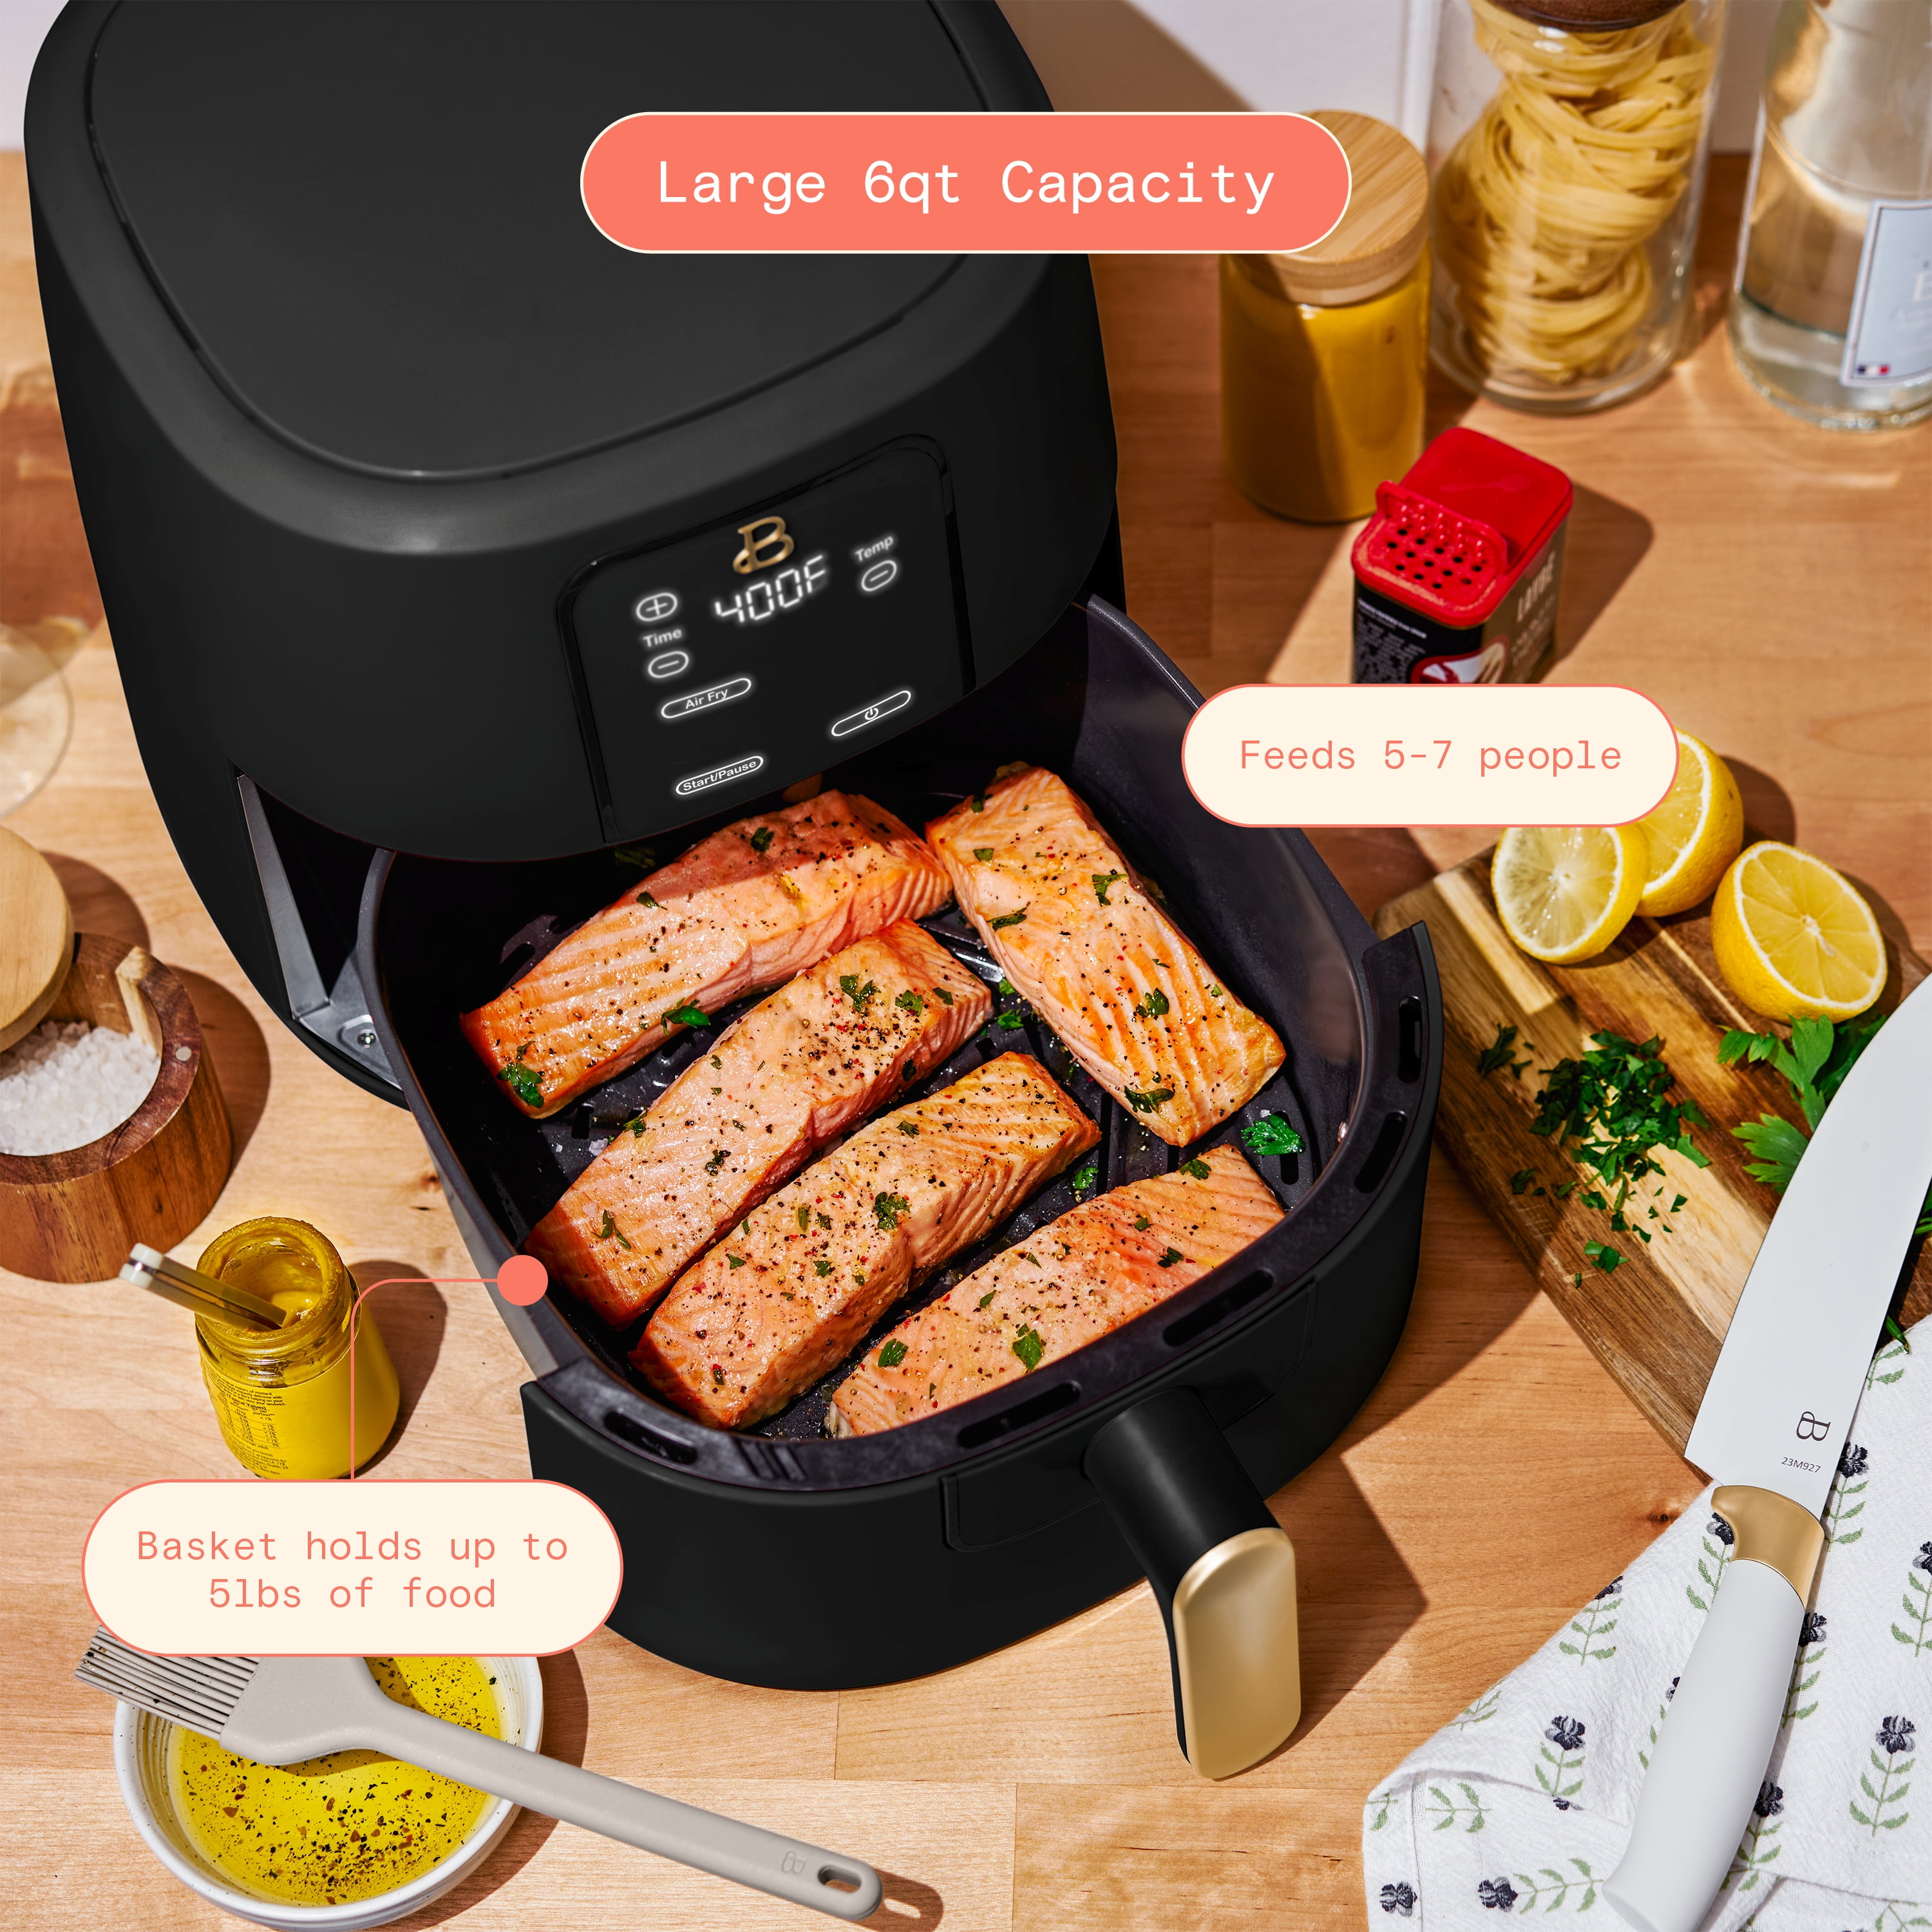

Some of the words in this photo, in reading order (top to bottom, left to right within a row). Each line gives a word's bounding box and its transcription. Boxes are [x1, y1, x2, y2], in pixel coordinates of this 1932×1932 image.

[733, 516, 794, 574] B
[854, 536, 894, 562] Temp
[714, 554, 826, 623] 400F
[643, 627, 683, 648] Time
[685, 697, 705, 710] Air
[708, 689, 728, 702] Fry
[683, 761, 757, 791] Start/Pause
[1796, 1411, 1831, 1441] B
[1781, 1457, 1821, 1473] 23M927
